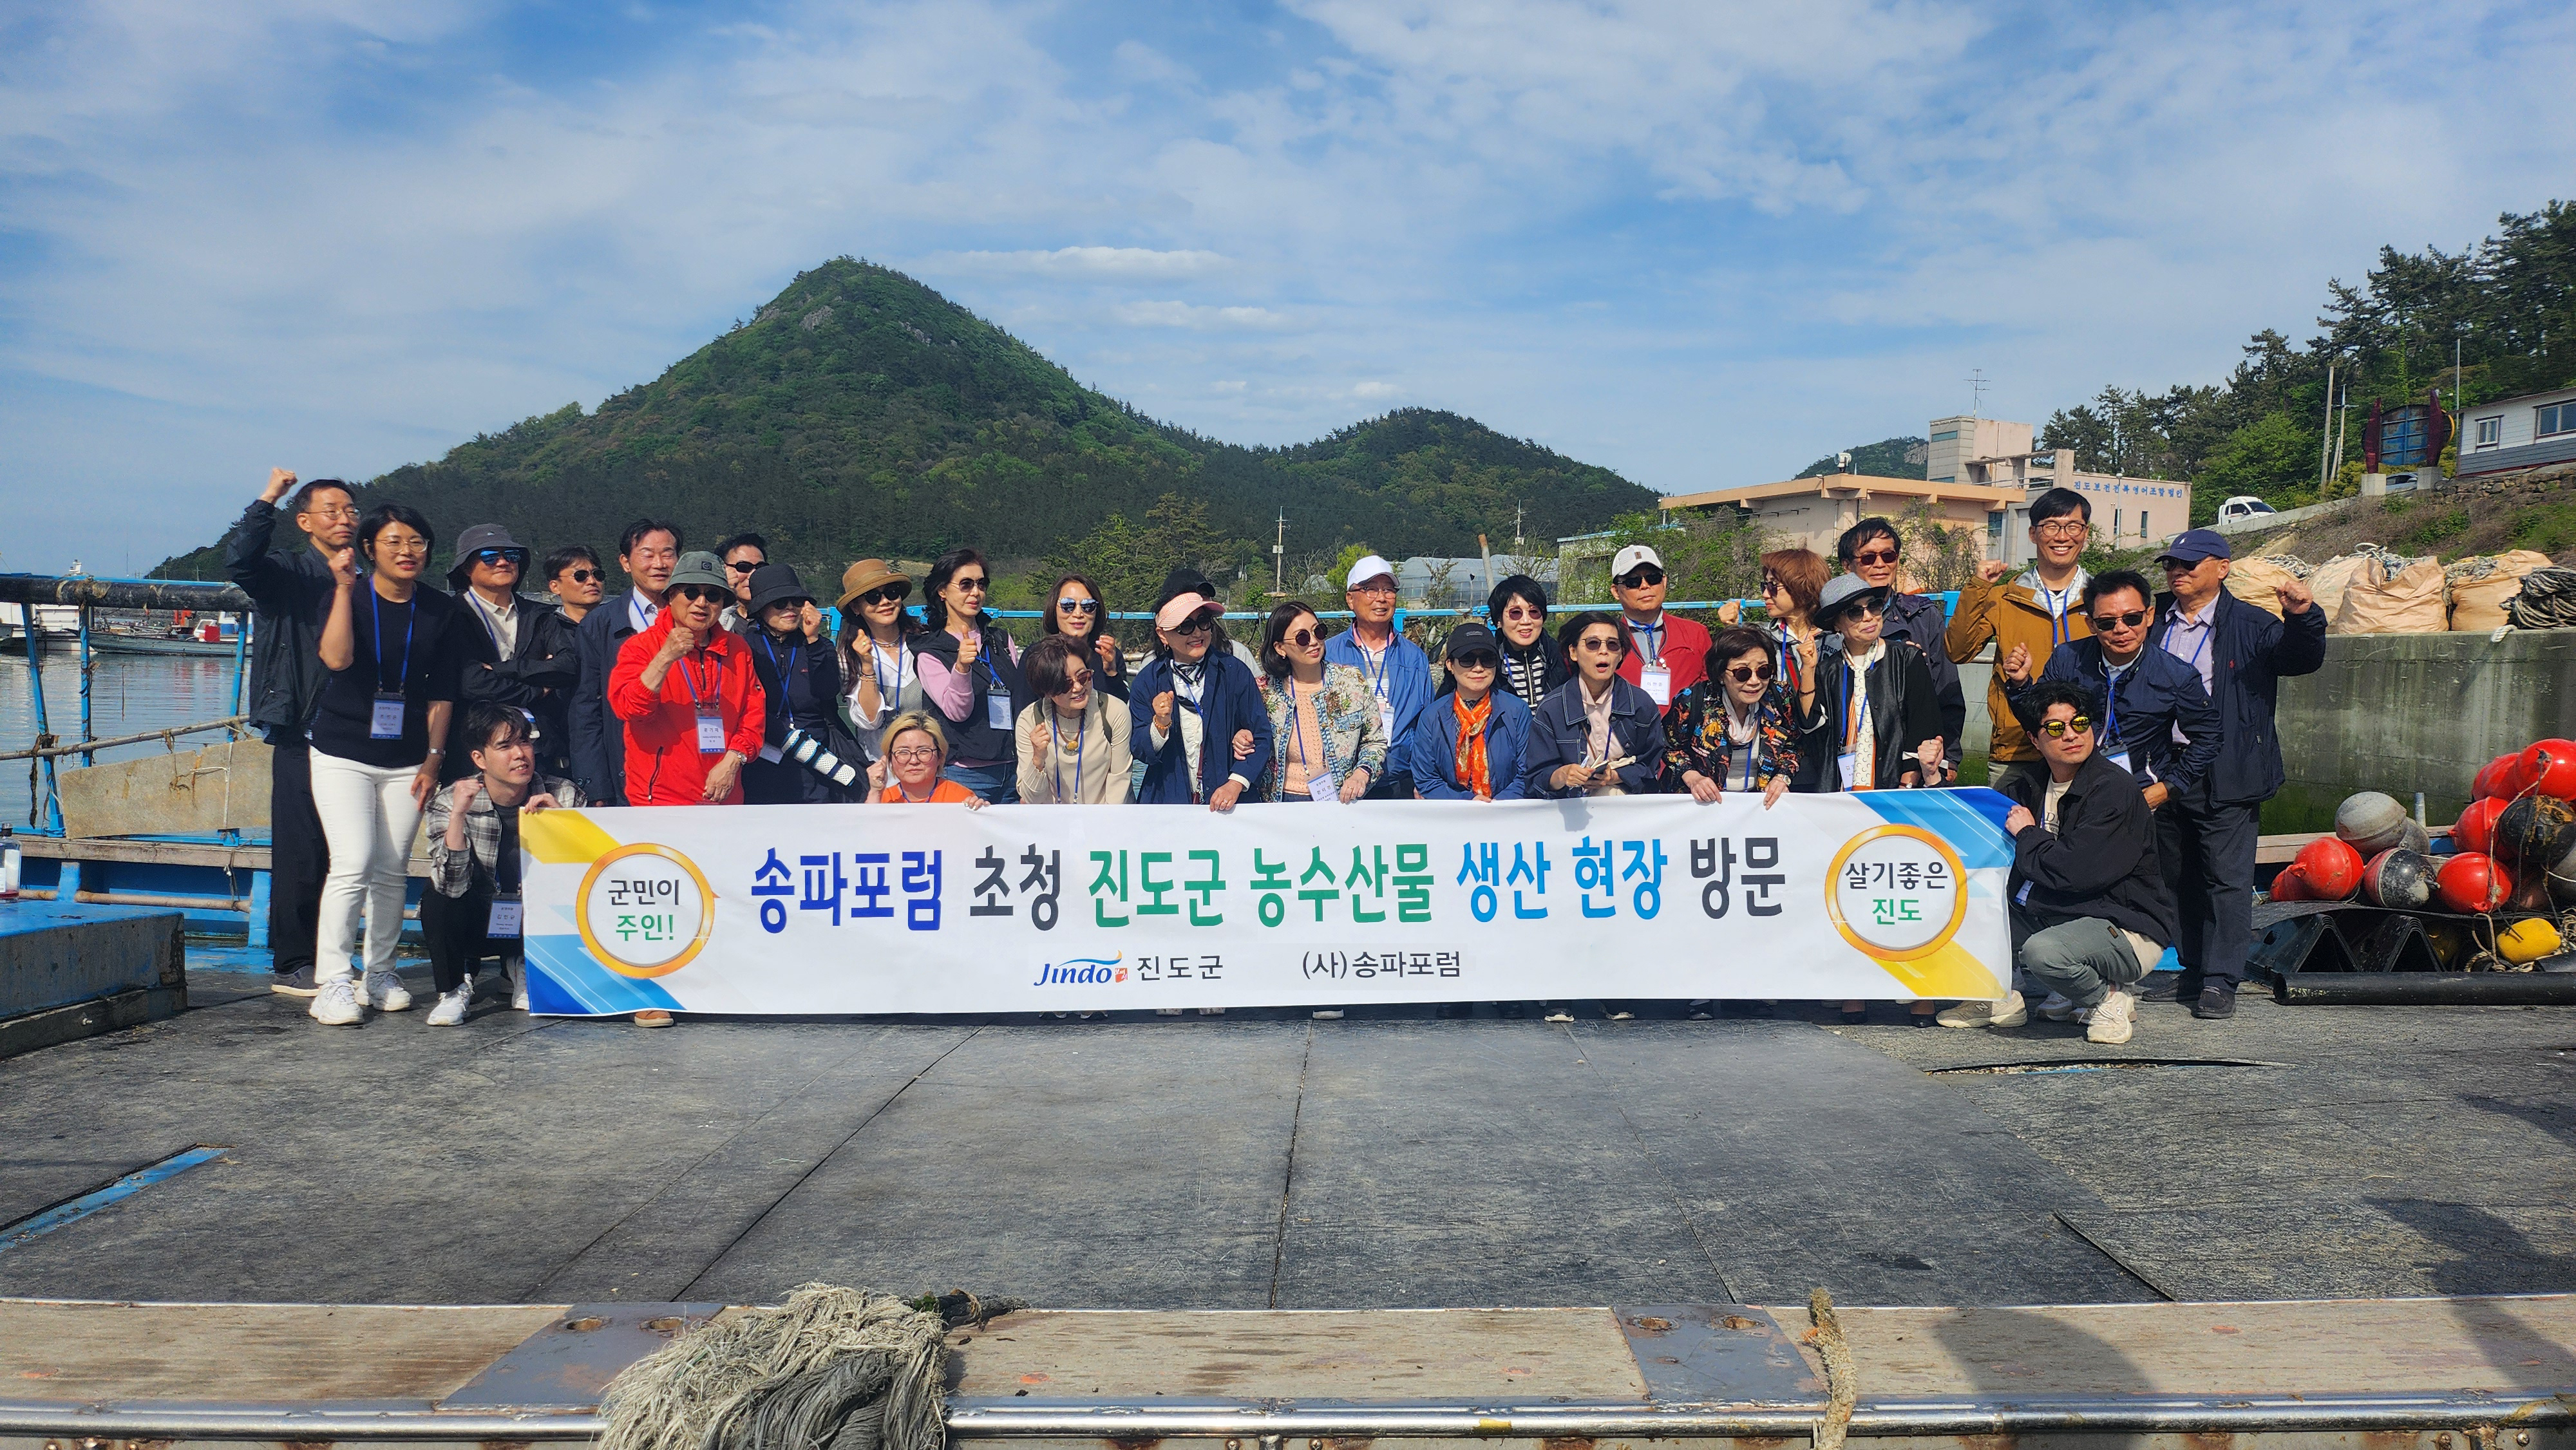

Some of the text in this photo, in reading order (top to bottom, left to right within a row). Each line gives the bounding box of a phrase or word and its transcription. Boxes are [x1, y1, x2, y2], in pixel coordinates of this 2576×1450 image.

[751, 835, 1786, 934] 송파포럼 초청 진도군 농수산물 생산 현장 방문
[1845, 861, 1948, 890] 살기좋은
[608, 880, 679, 906] 군민이
[1872, 898, 1922, 925] 진도
[616, 914, 674, 941] 주인!
[1033, 963, 1113, 986] Jindo
[1137, 955, 1224, 981] 진도군
